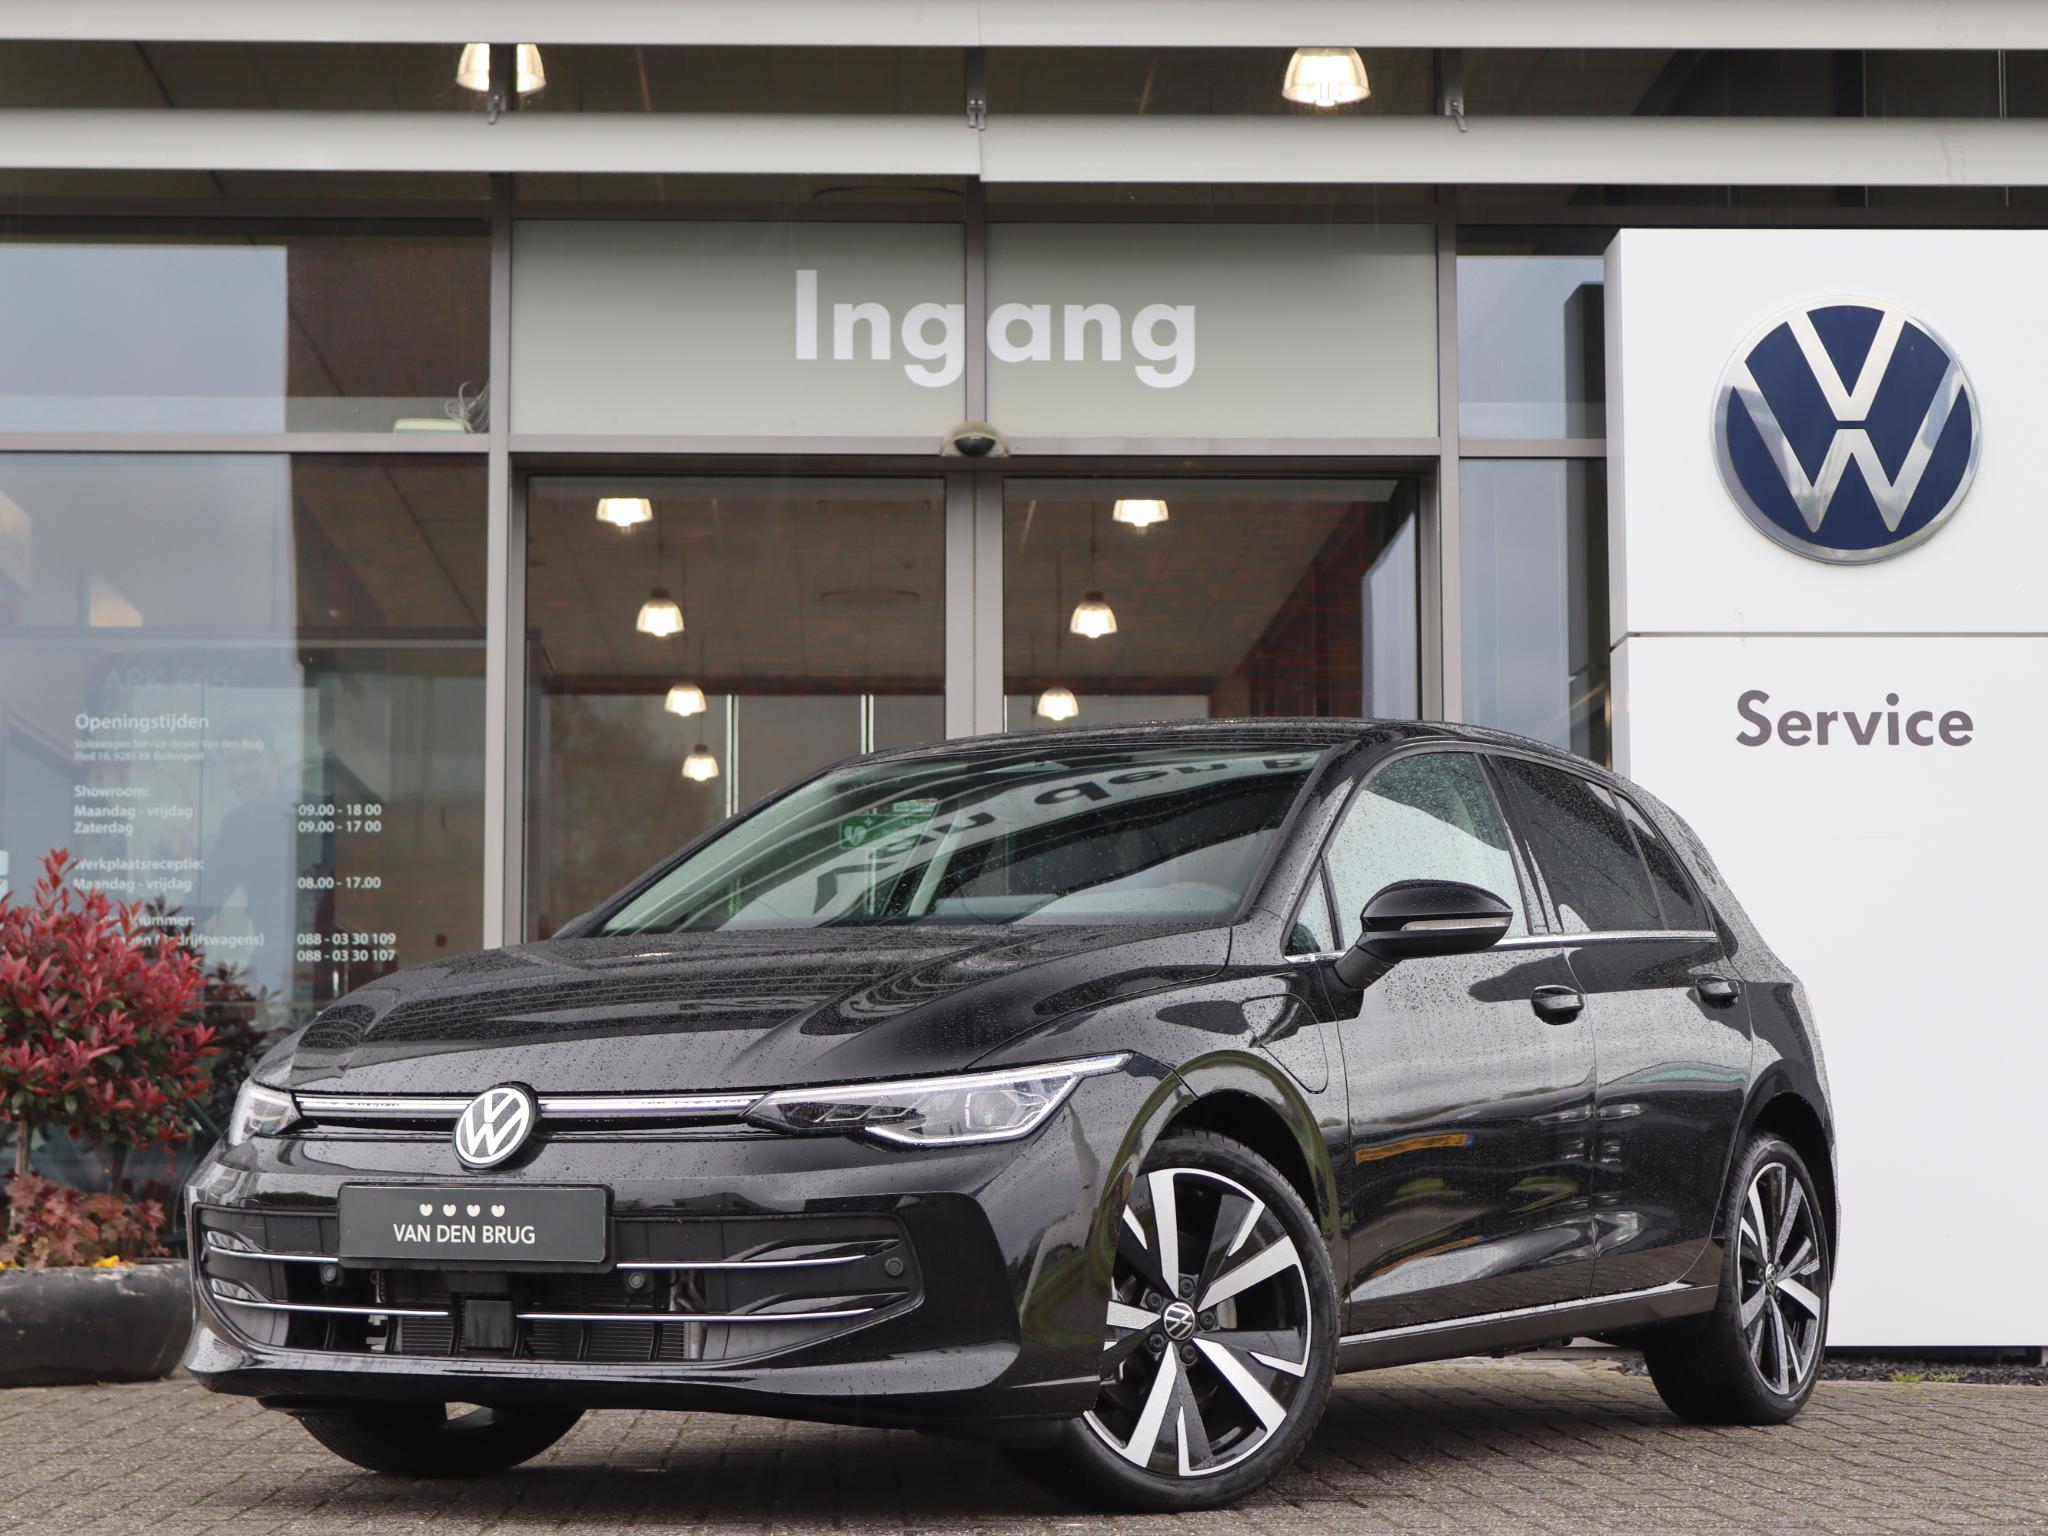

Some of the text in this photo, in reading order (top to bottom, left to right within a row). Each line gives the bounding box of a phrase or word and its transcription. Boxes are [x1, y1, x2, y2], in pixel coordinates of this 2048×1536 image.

[796, 269, 1196, 388] Ingang
[75, 713, 209, 733] Openingstijden
[1735, 689, 1974, 747] Service
[74, 785, 150, 798] Showroom:
[74, 805, 136, 819] Maandag
[147, 804, 194, 820] vrijdag
[298, 804, 335, 816] 09.00
[74, 822, 134, 836] Zaterdag
[298, 820, 335, 832] 09.00
[74, 858, 205, 873] Werkplaatsreceptie:
[73, 878, 135, 893] Maandag
[146, 878, 192, 893] vrijdag
[297, 876, 335, 889] 08.00
[345, 876, 382, 889] 17.00
[297, 933, 322, 945] 088
[332, 933, 349, 945] 03
[352, 933, 369, 945] 30
[372, 933, 396, 945] 109
[297, 949, 322, 962] 088
[332, 949, 349, 962] 03
[352, 949, 369, 962] 30
[372, 949, 396, 962] 107
[393, 1223, 536, 1245] VAN DEN BRUG
